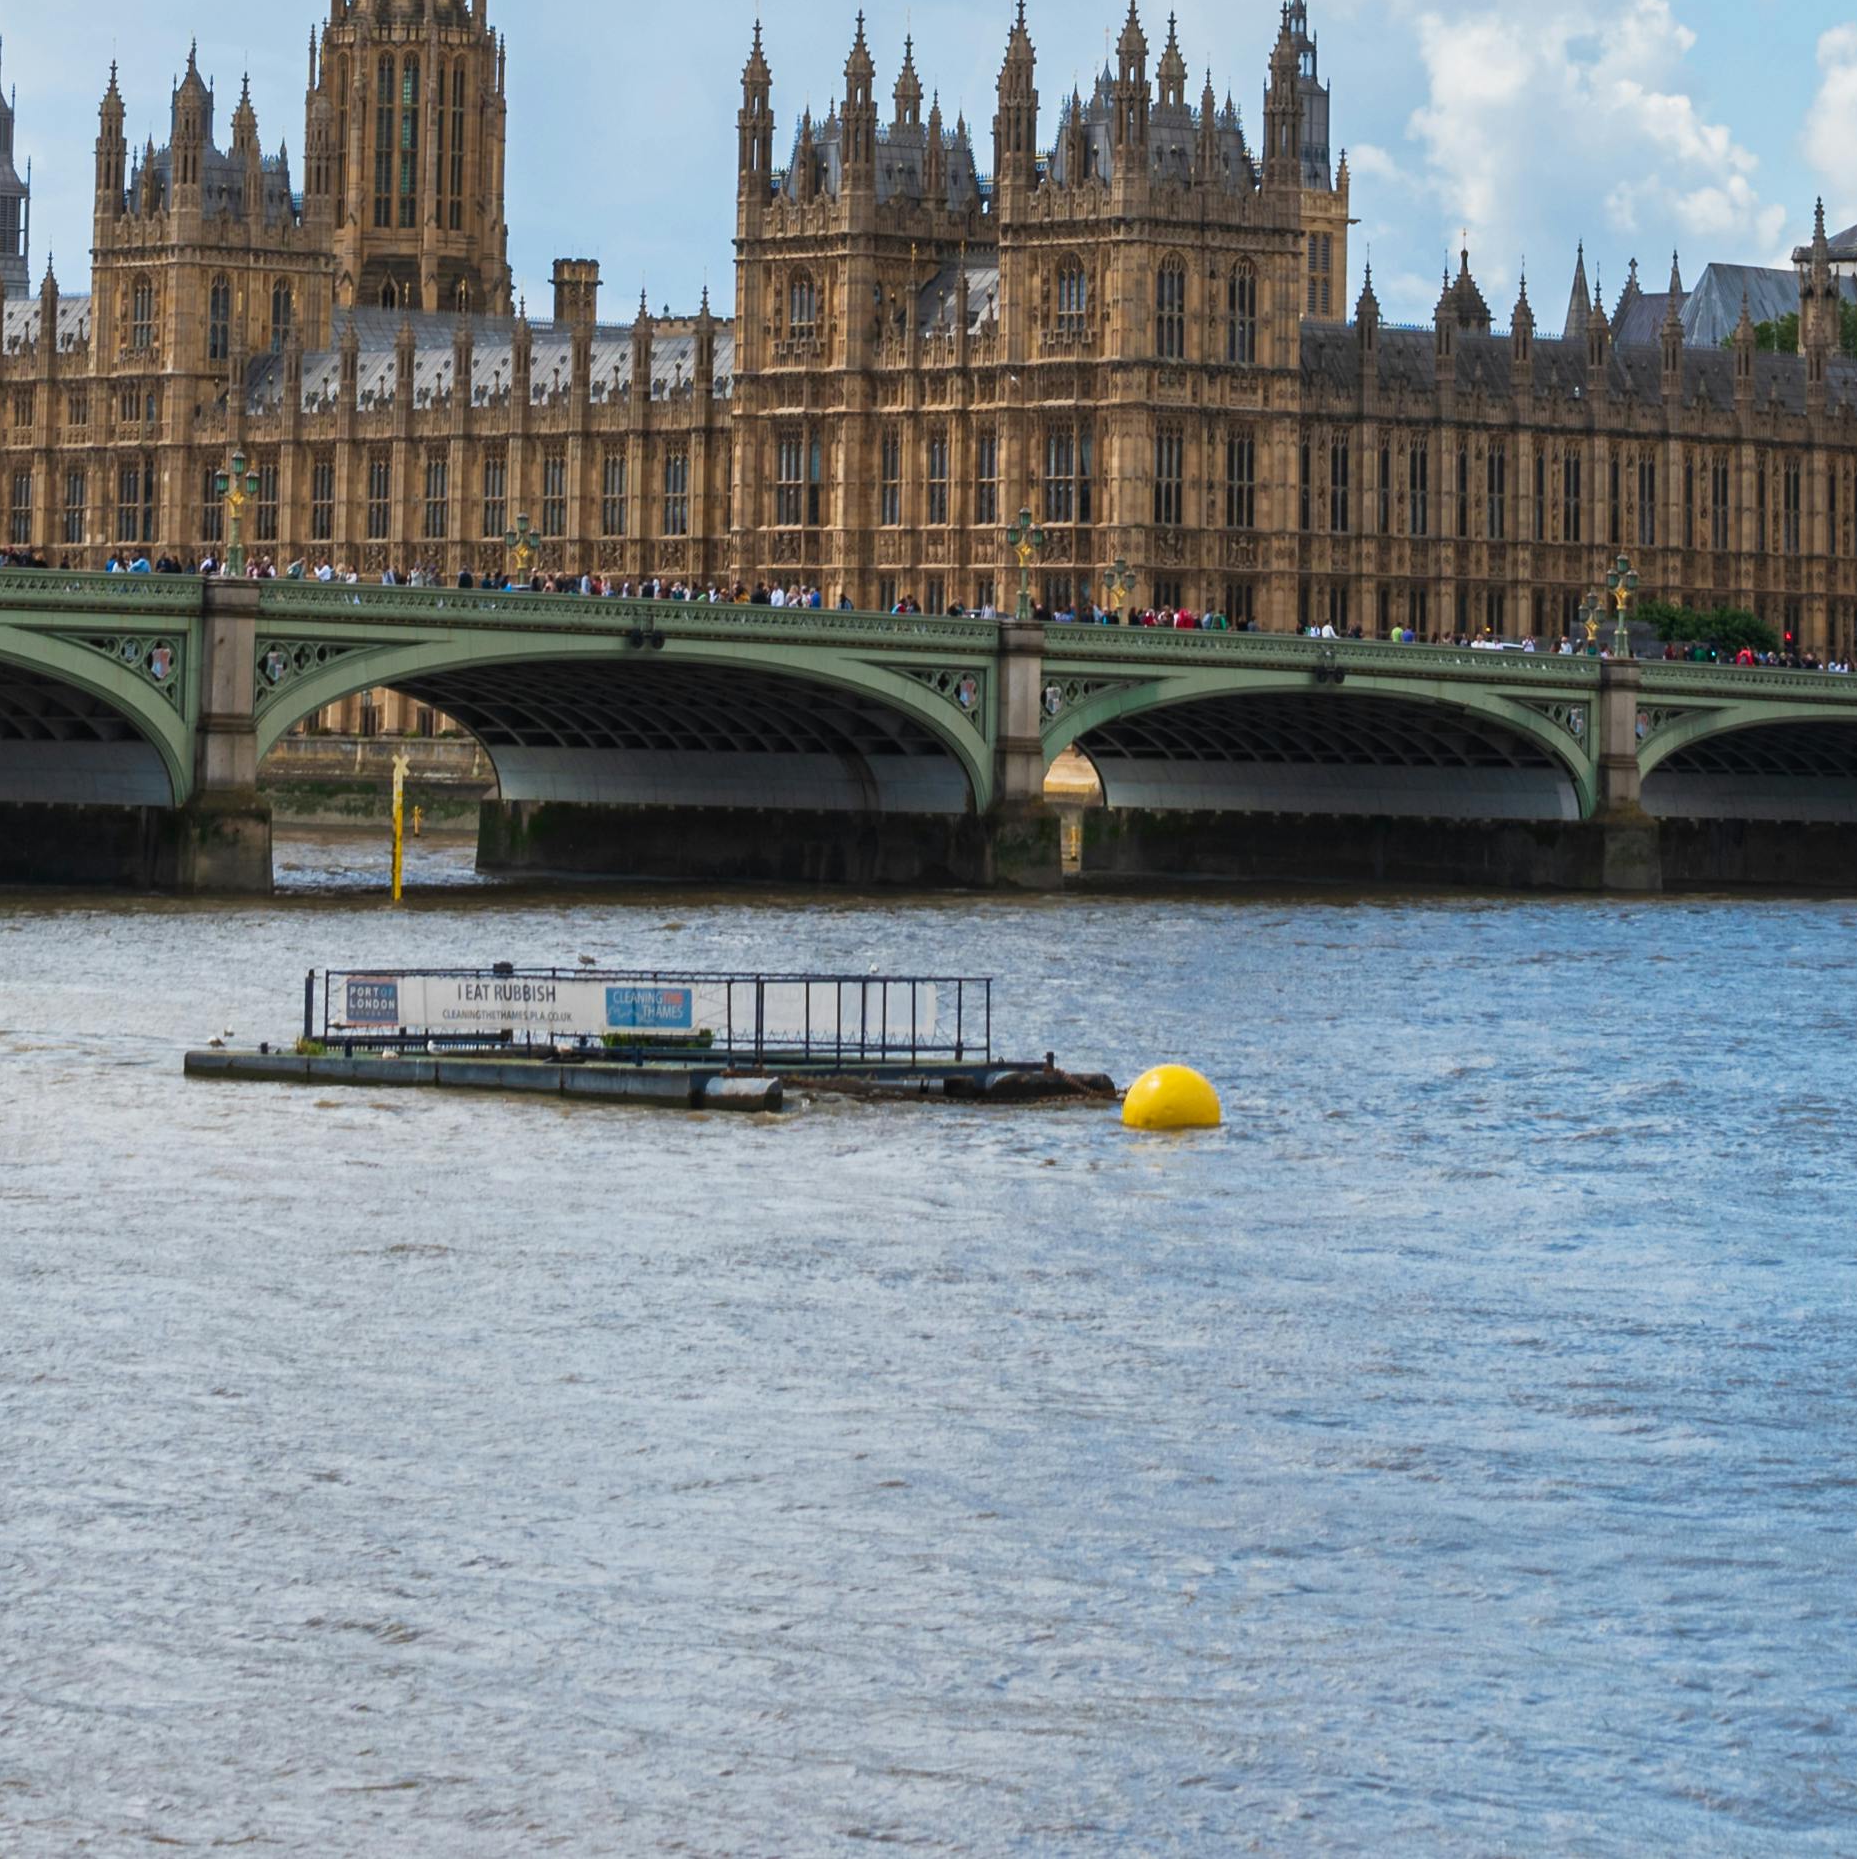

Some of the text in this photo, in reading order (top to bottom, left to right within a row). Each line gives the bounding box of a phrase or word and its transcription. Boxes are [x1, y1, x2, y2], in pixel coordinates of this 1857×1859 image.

[458, 984, 556, 1002] I EAT RUBBISH
[350, 998, 395, 1009] LONDON
[643, 1005, 683, 1019] THAMES
